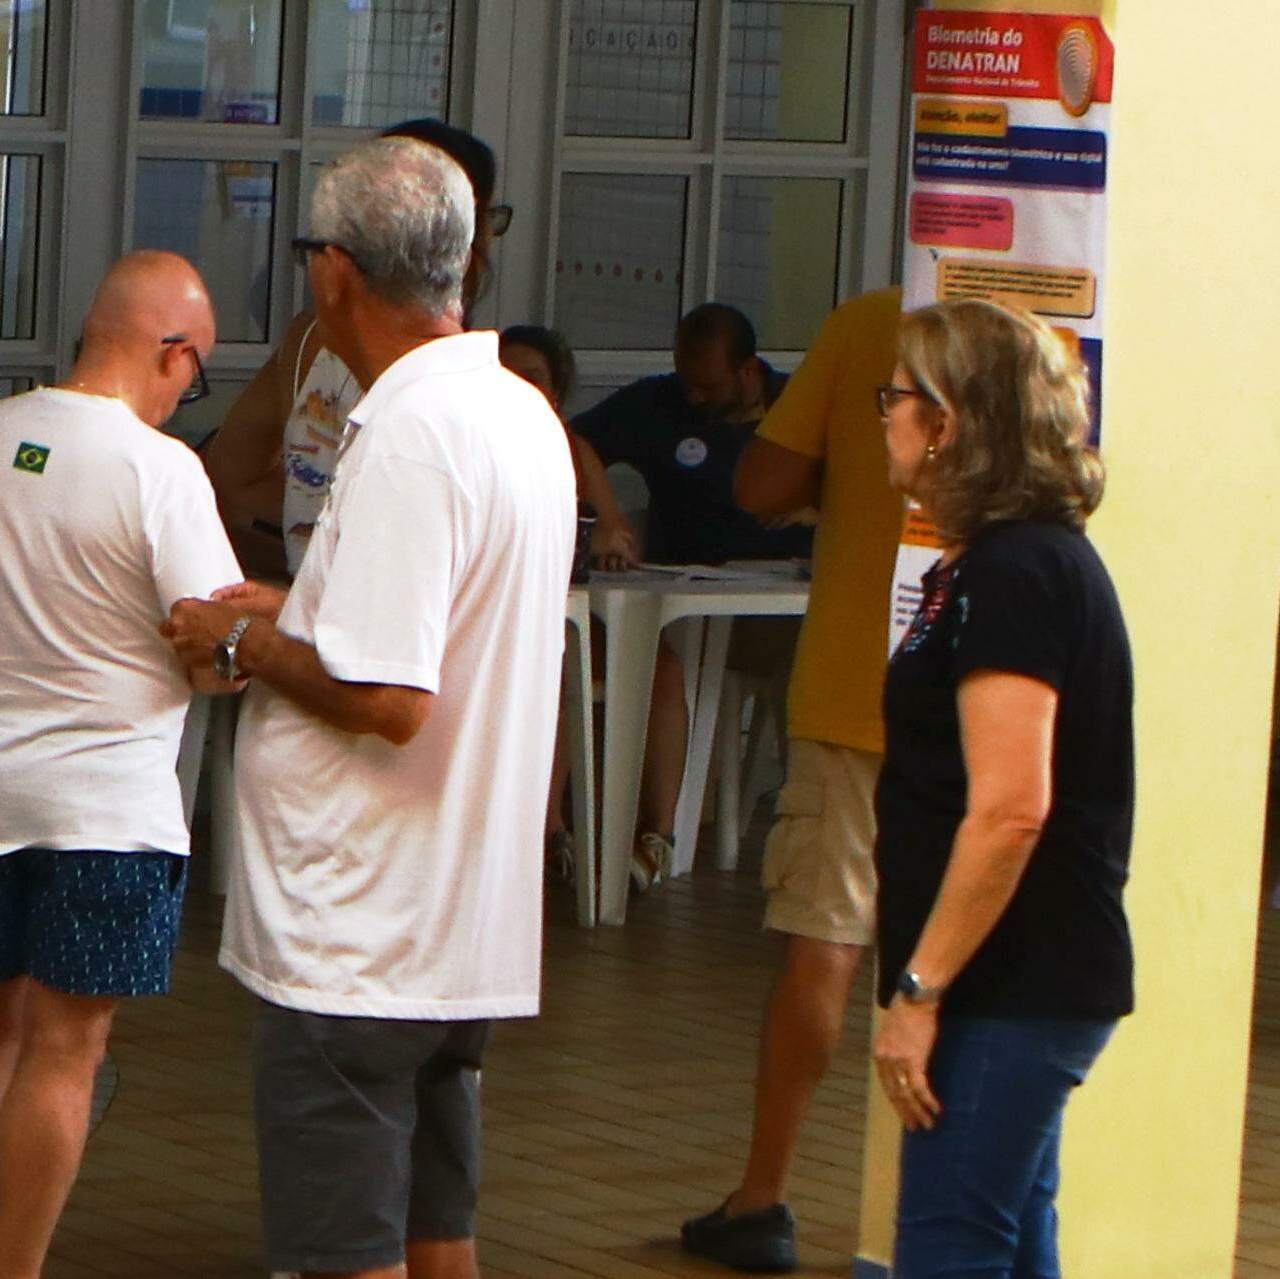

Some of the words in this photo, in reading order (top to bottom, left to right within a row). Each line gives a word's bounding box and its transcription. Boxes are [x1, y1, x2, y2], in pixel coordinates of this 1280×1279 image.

[928, 24, 999, 46] Biometria
[1002, 27, 1023, 47] do
[926, 50, 1021, 73] DENATRAN
